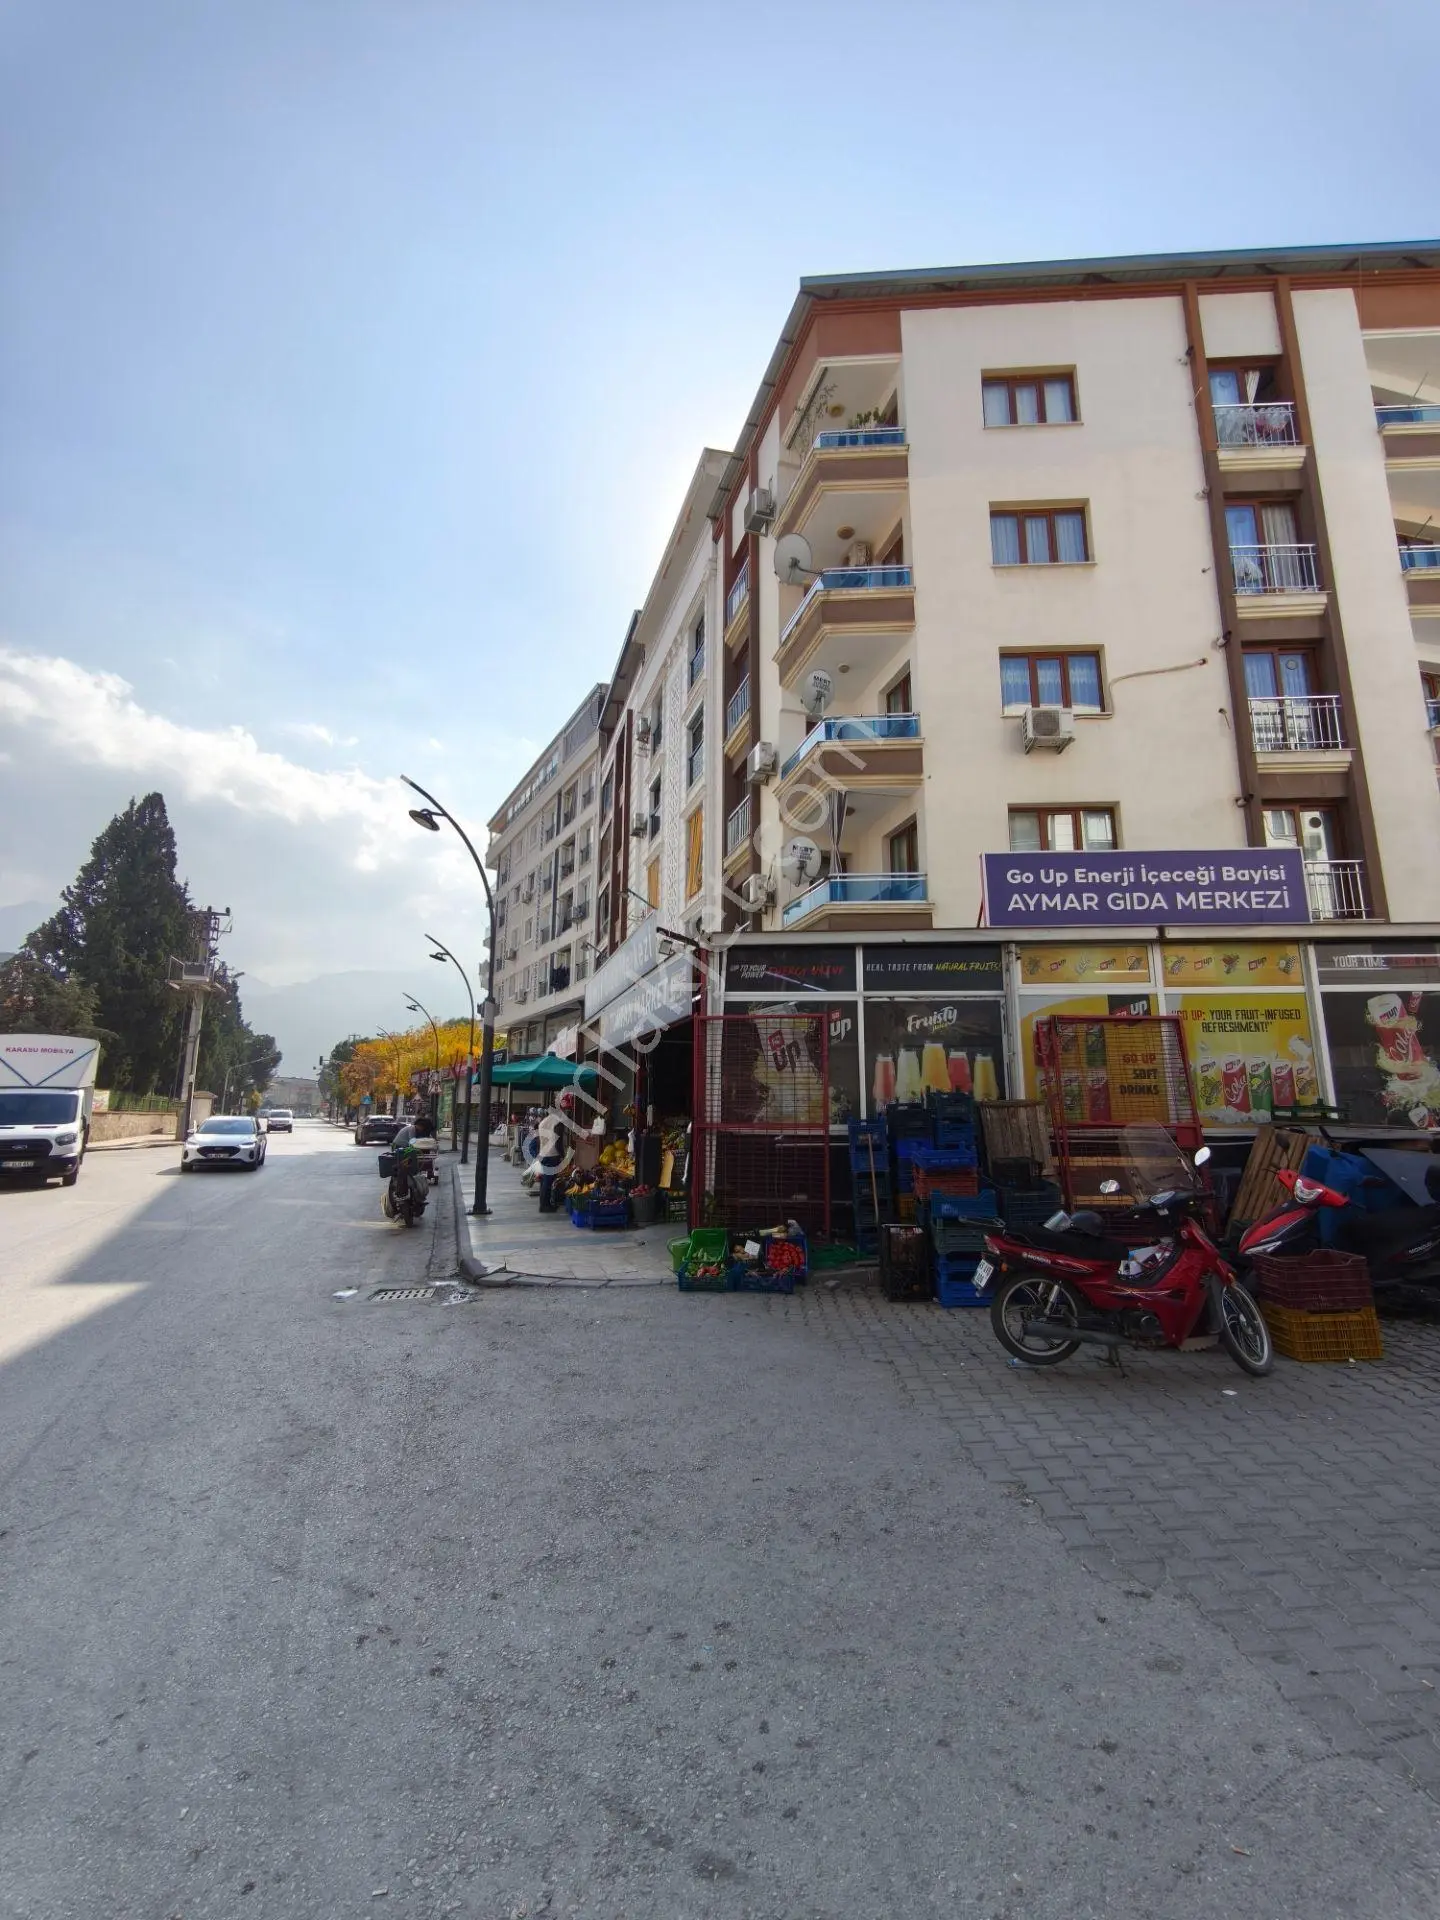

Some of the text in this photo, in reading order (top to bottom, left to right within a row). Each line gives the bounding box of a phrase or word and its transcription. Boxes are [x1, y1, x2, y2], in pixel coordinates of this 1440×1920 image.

[1006, 864, 1286, 887] Go Up Enerji İçeceği Bayisi
[1007, 886, 1291, 912] AYMAR GIDA MERKEZİ
[866, 963, 884, 972] REAL
[887, 963, 911, 972] TASTE
[913, 963, 933, 972] FROM
[935, 962, 968, 972] NATURAL
[1332, 955, 1358, 969] YOUR
[749, 964, 767, 972] YOUR
[741, 971, 765, 979] POWER
[1210, 1010, 1232, 1020] YOUR
[1234, 1009, 1301, 1020] FRUIT-INFUSED
